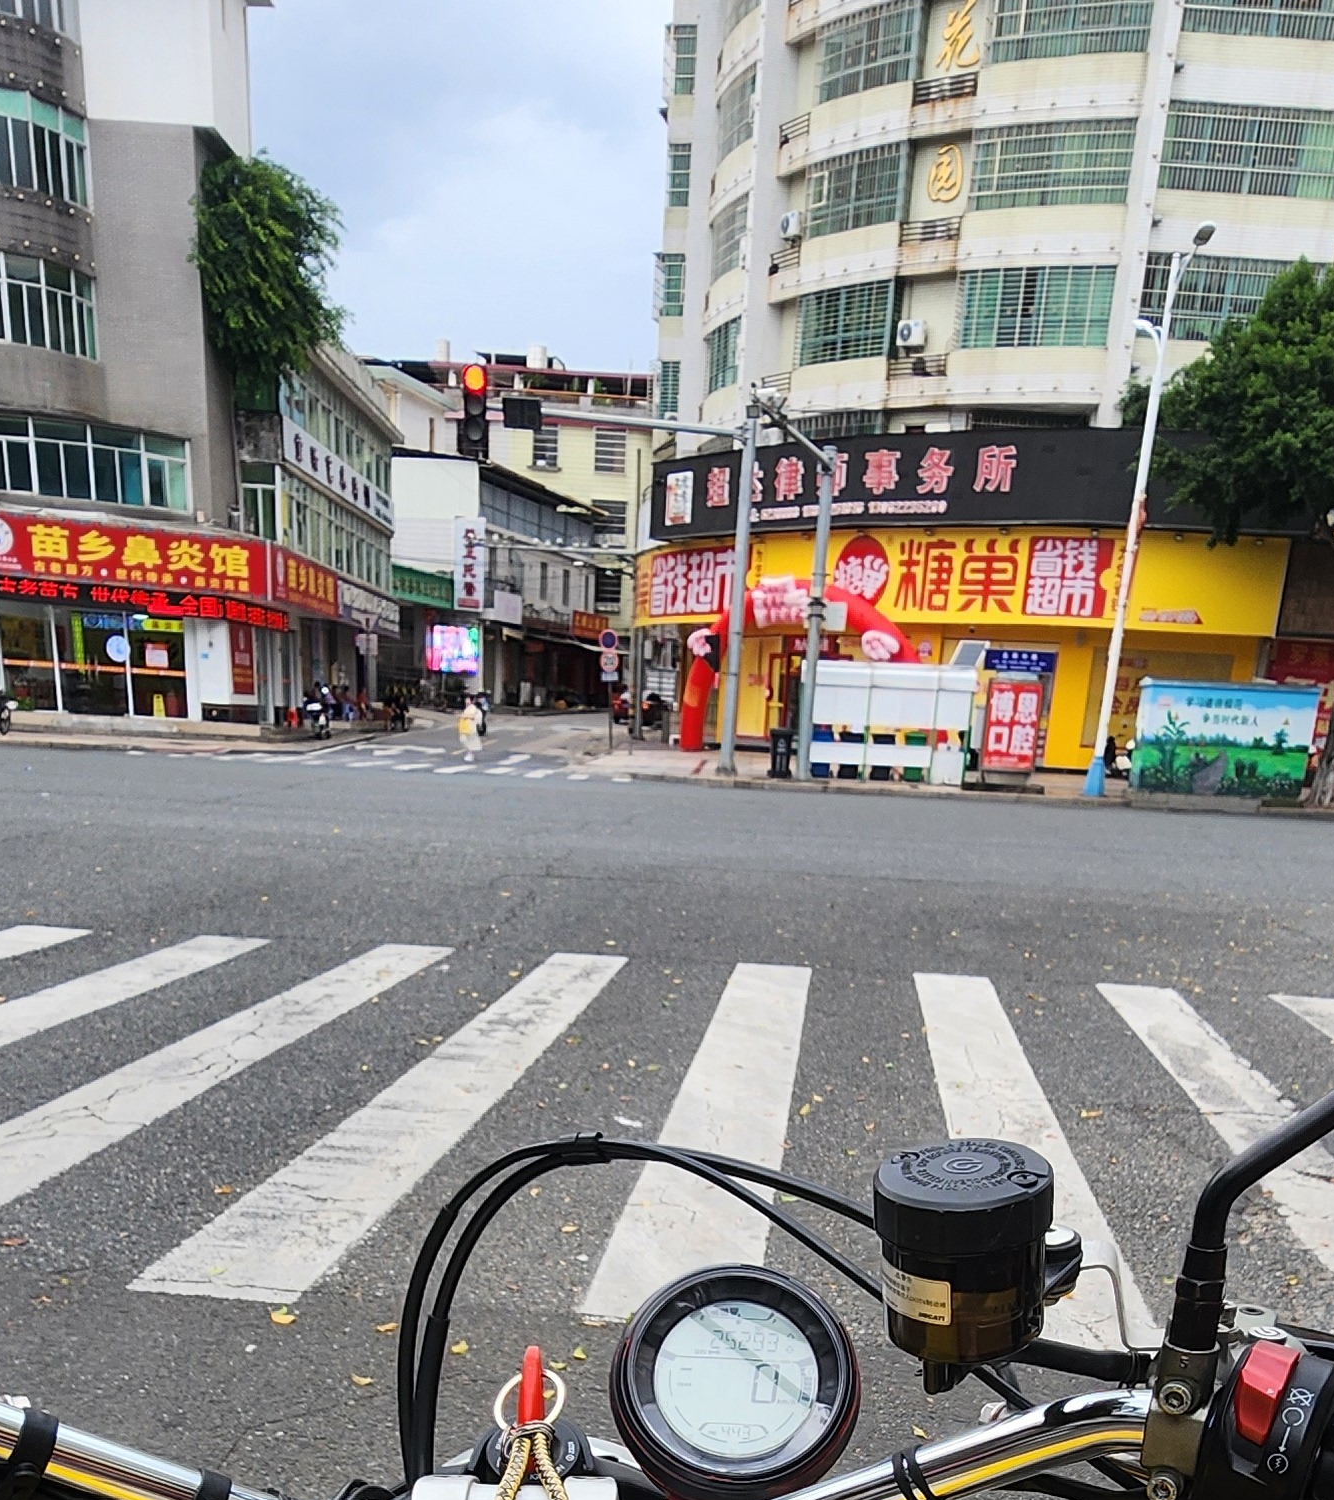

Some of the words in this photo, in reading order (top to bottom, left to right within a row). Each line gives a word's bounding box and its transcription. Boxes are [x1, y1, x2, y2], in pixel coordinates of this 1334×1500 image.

[26, 523, 250, 580] 苗乡鼻炎馆
[751, 1363, 780, 1404] 0
